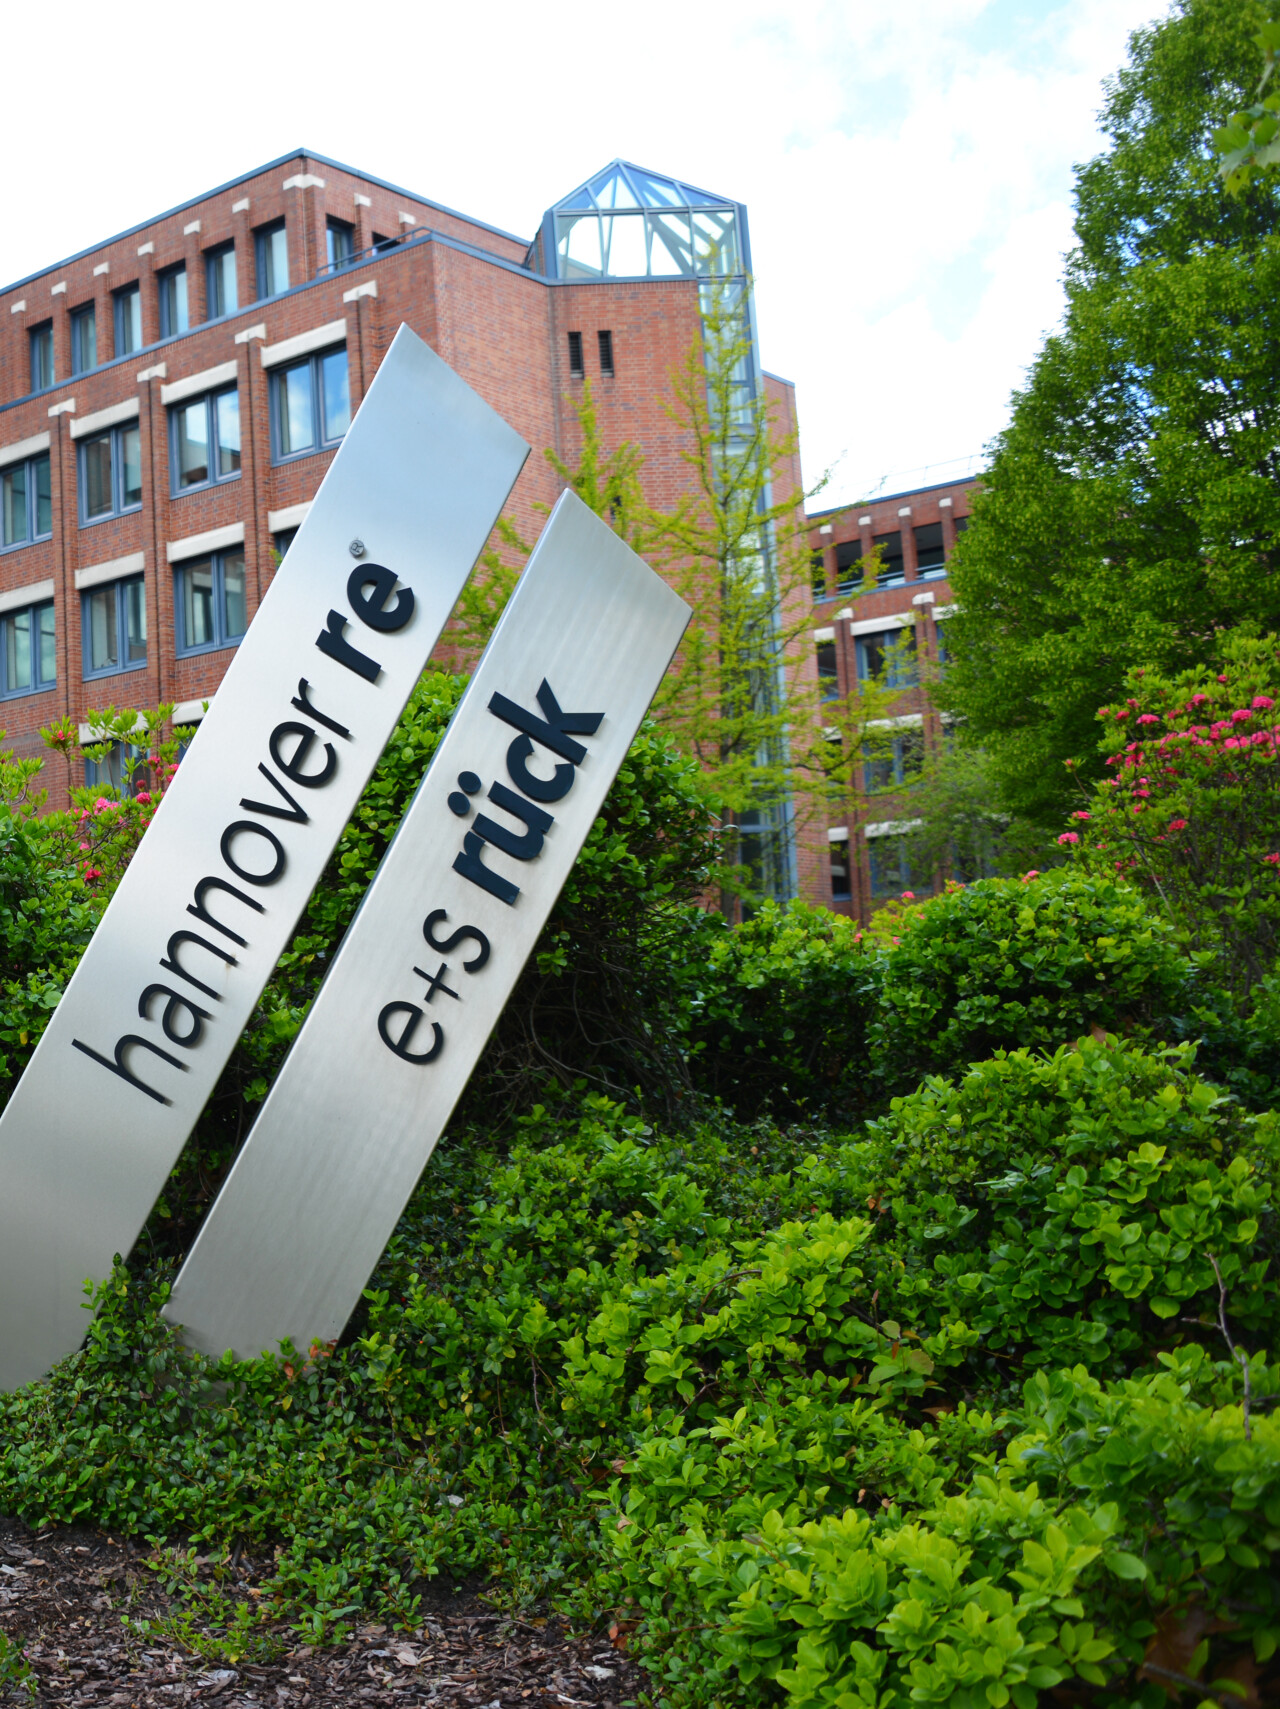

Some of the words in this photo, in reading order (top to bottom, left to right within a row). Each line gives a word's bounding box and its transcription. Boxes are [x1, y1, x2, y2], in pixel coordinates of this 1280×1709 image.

[71, 677, 352, 1106] hannover
[377, 908, 491, 1066] e+s
[447, 677, 606, 907] rück
